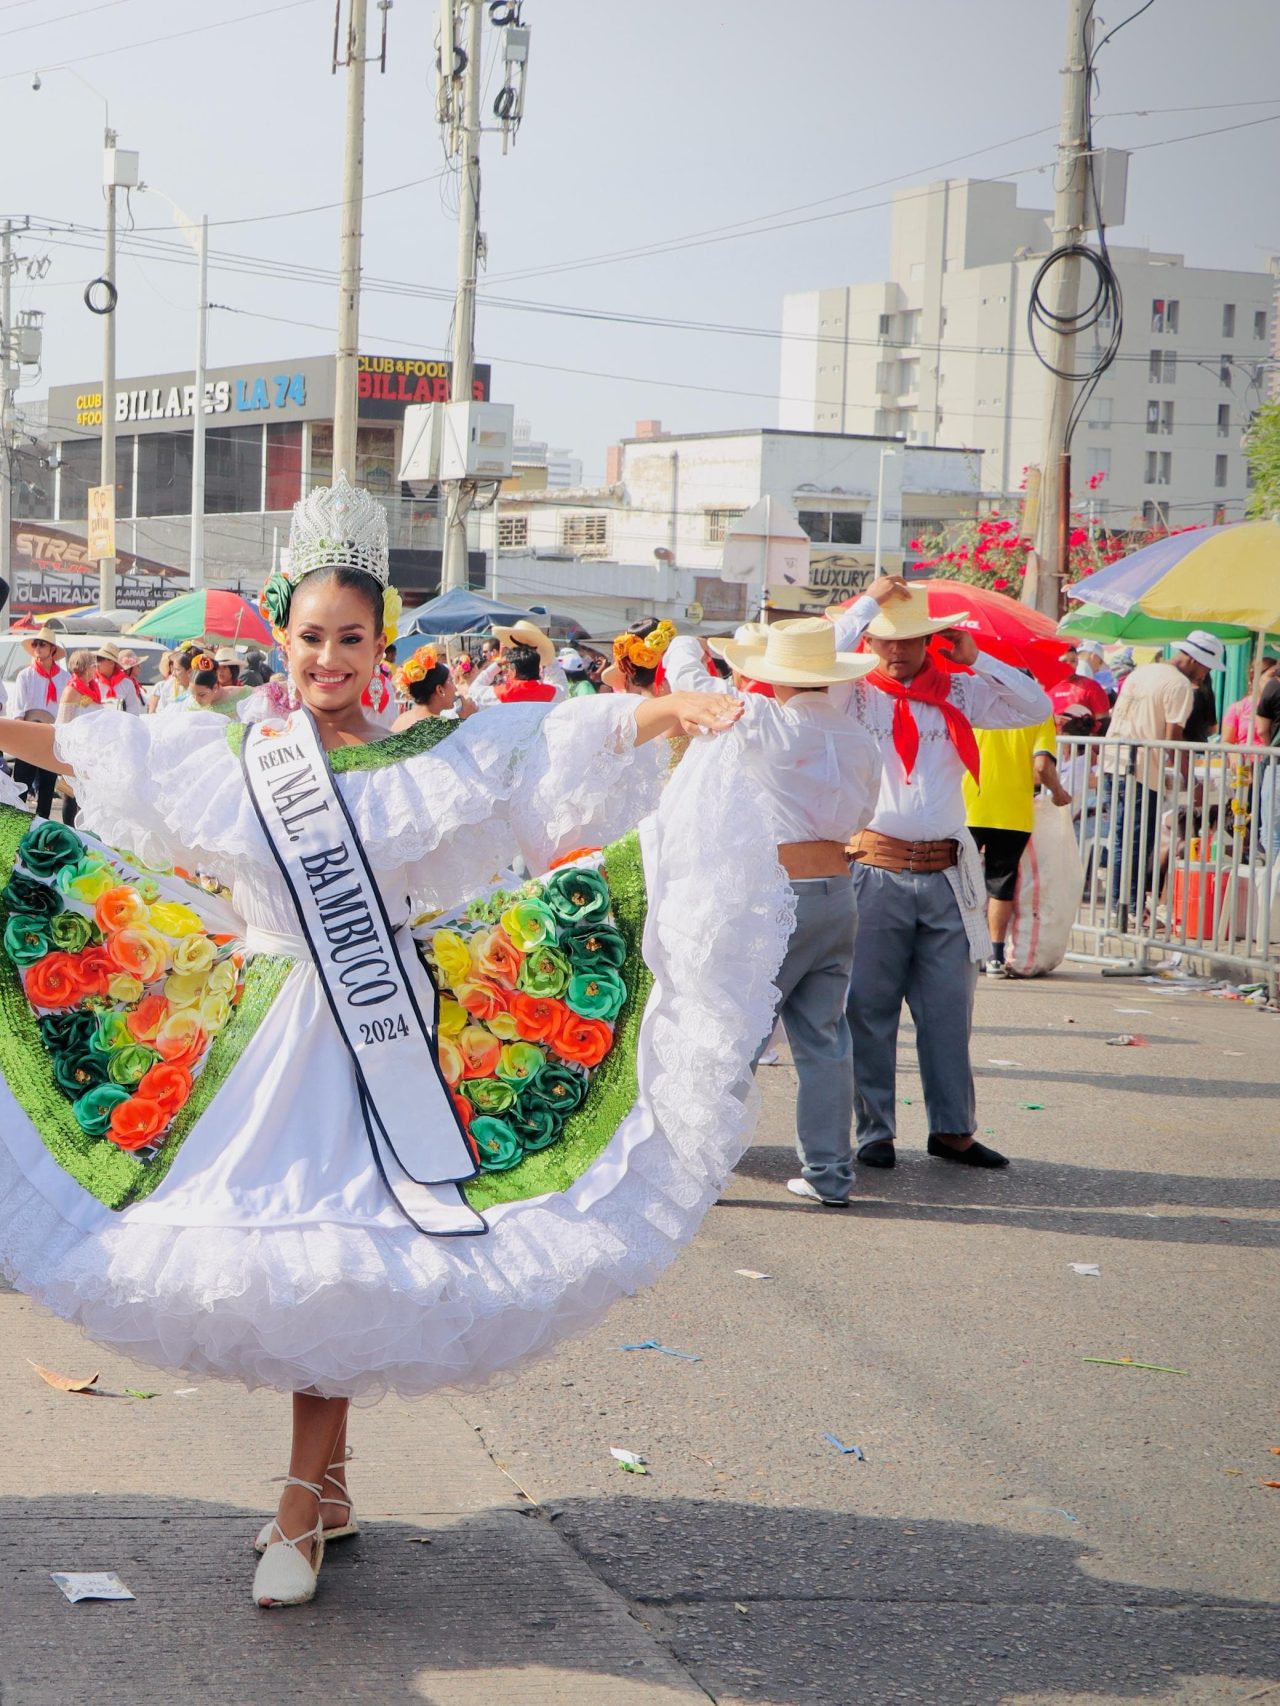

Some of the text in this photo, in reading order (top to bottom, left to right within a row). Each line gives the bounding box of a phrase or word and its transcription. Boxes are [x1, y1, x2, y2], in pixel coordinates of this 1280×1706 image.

[76, 393, 102, 410] CLUB
[235, 376, 270, 411] LA
[273, 372, 307, 408] 74
[358, 372, 485, 402] BILLARS
[76, 412, 104, 426] &FOO
[16, 532, 99, 569] STRE
[813, 568, 869, 587] LUXURY
[12, 586, 100, 604] OLARIZADO
[829, 588, 867, 604] ZON
[257, 743, 306, 772] REINA
[267, 762, 399, 1007] NAL. BAMBUCO
[359, 1013, 410, 1046] 2024
